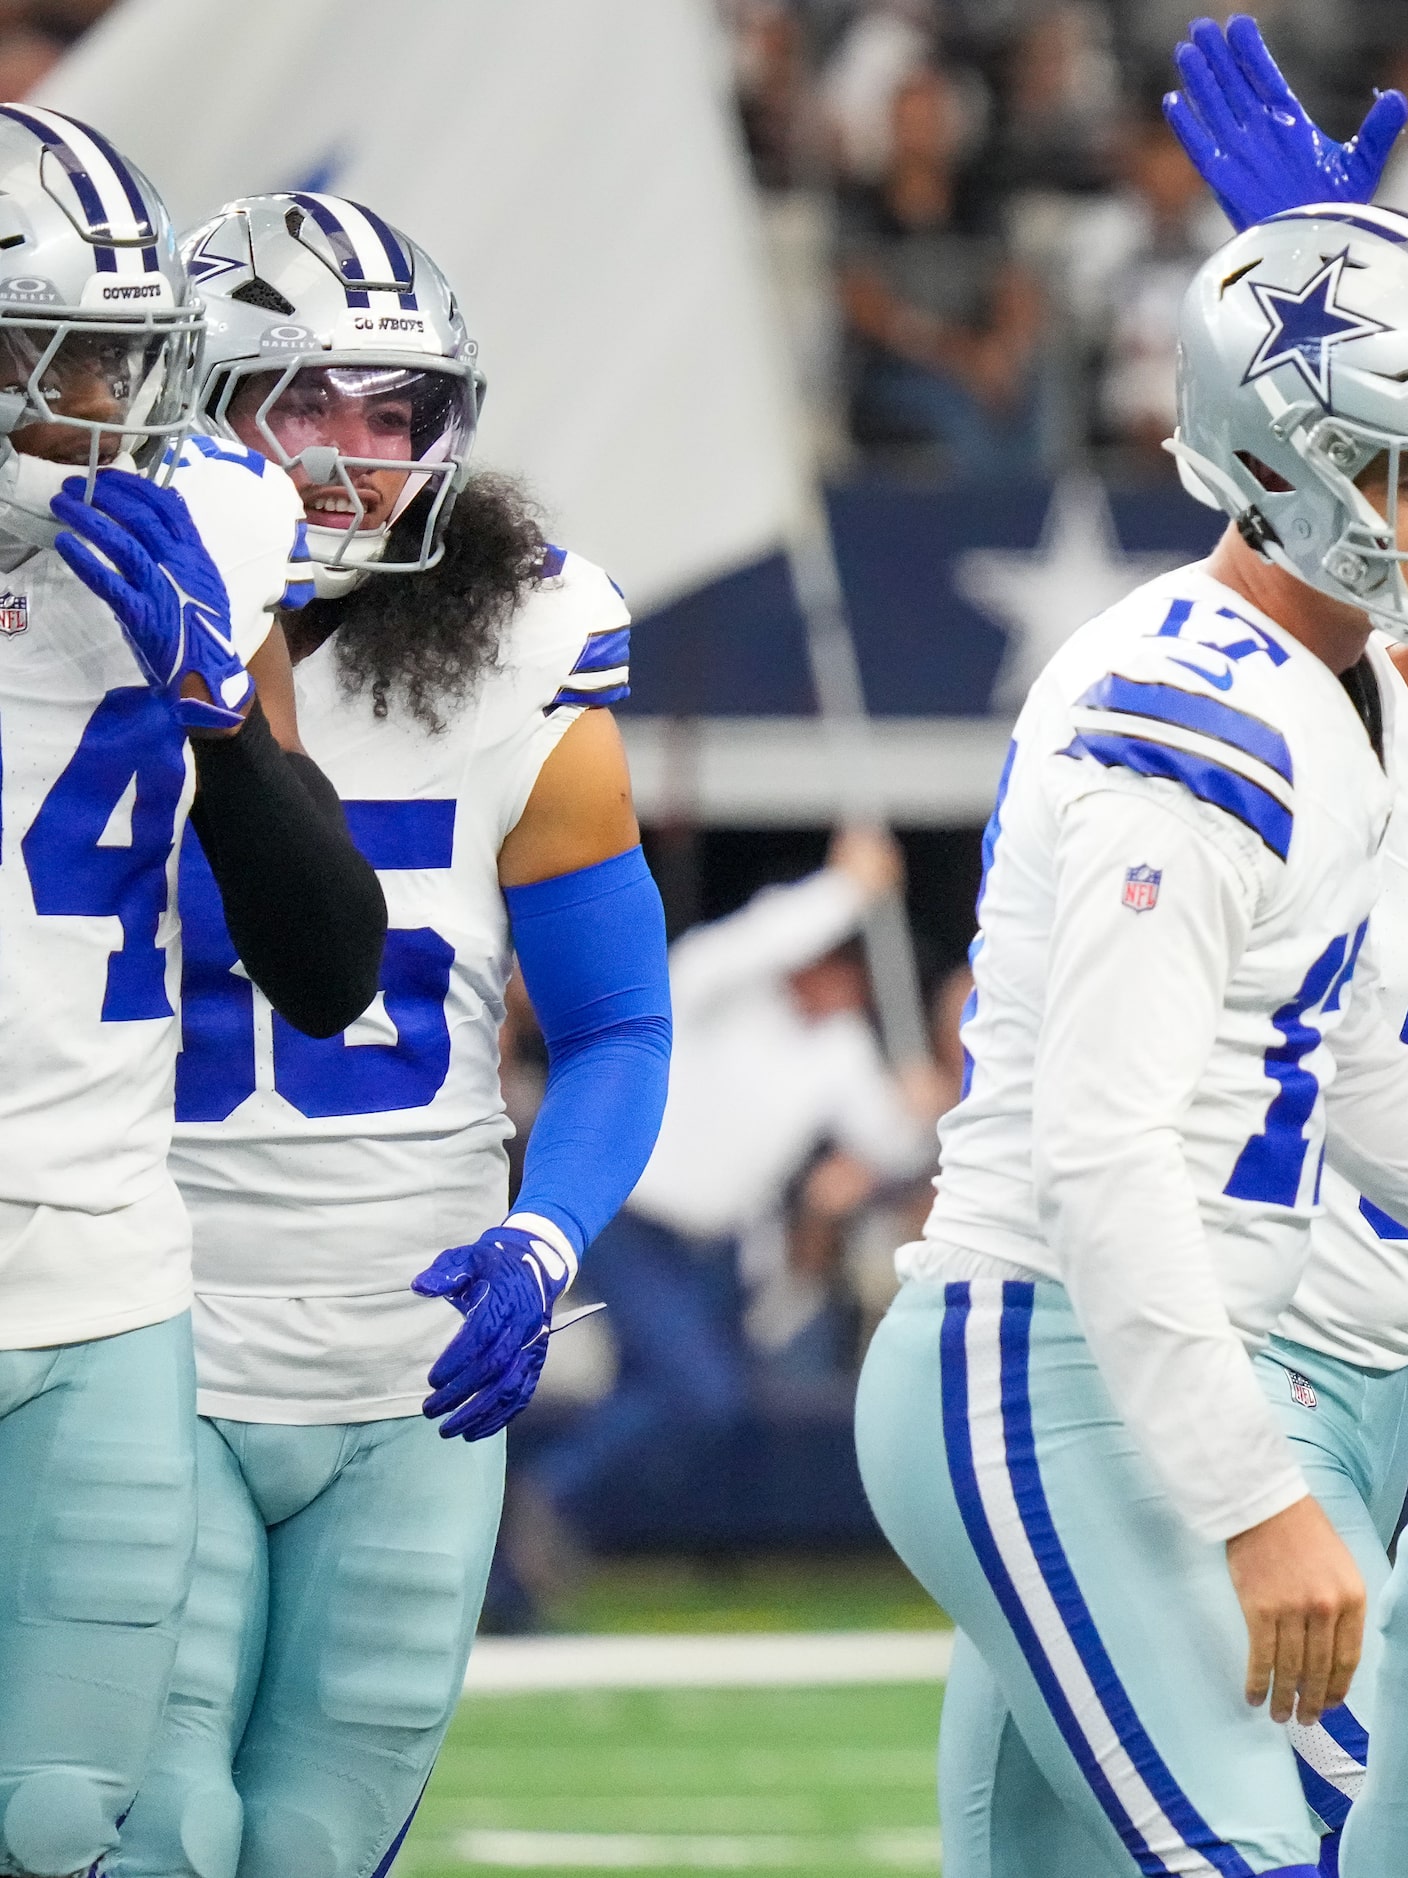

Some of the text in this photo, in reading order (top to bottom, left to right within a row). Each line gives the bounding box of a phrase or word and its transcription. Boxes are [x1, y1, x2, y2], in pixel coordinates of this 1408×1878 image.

[103, 284, 161, 300] COWBOYS
[354, 317, 424, 333] COWBOYS
[262, 340, 315, 348] OAKLEY
[1142, 598, 1291, 667] 17
[1125, 882, 1156, 907] NFL
[1223, 917, 1369, 1208] 1
[1295, 1383, 1315, 1404] NFL
